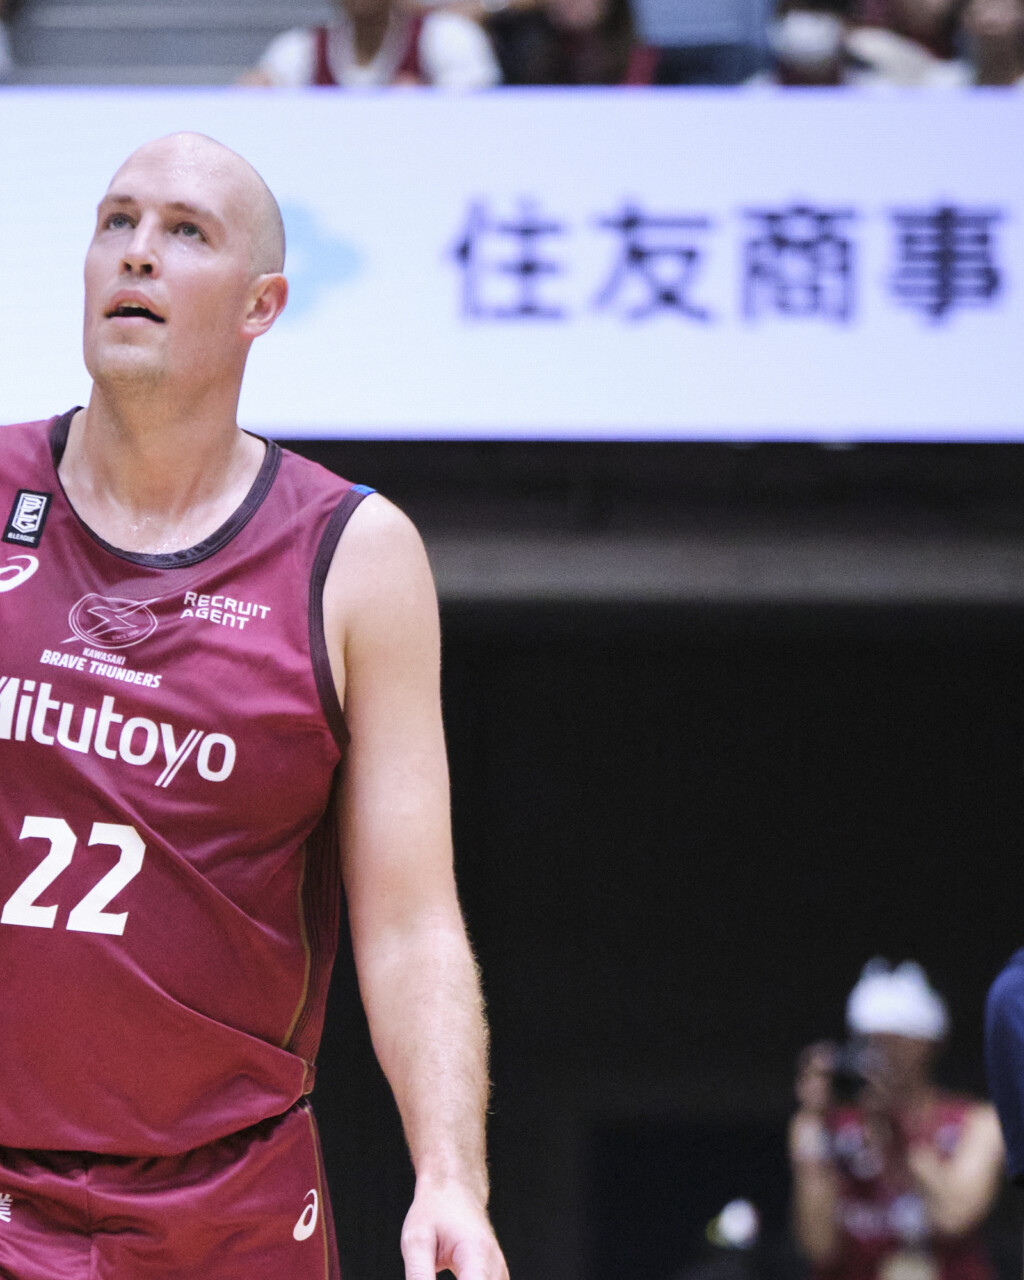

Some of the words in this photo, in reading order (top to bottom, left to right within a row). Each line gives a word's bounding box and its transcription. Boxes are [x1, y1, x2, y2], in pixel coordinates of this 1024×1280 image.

[449, 198, 1006, 326] 住友商事
[180, 607, 249, 630] AGENT
[183, 591, 271, 619] RECRUIT
[40, 649, 85, 672] BRAVE
[88, 661, 163, 689] THUNDERS
[82, 647, 126, 666] KAWASAKI
[0, 815, 146, 936] 22
